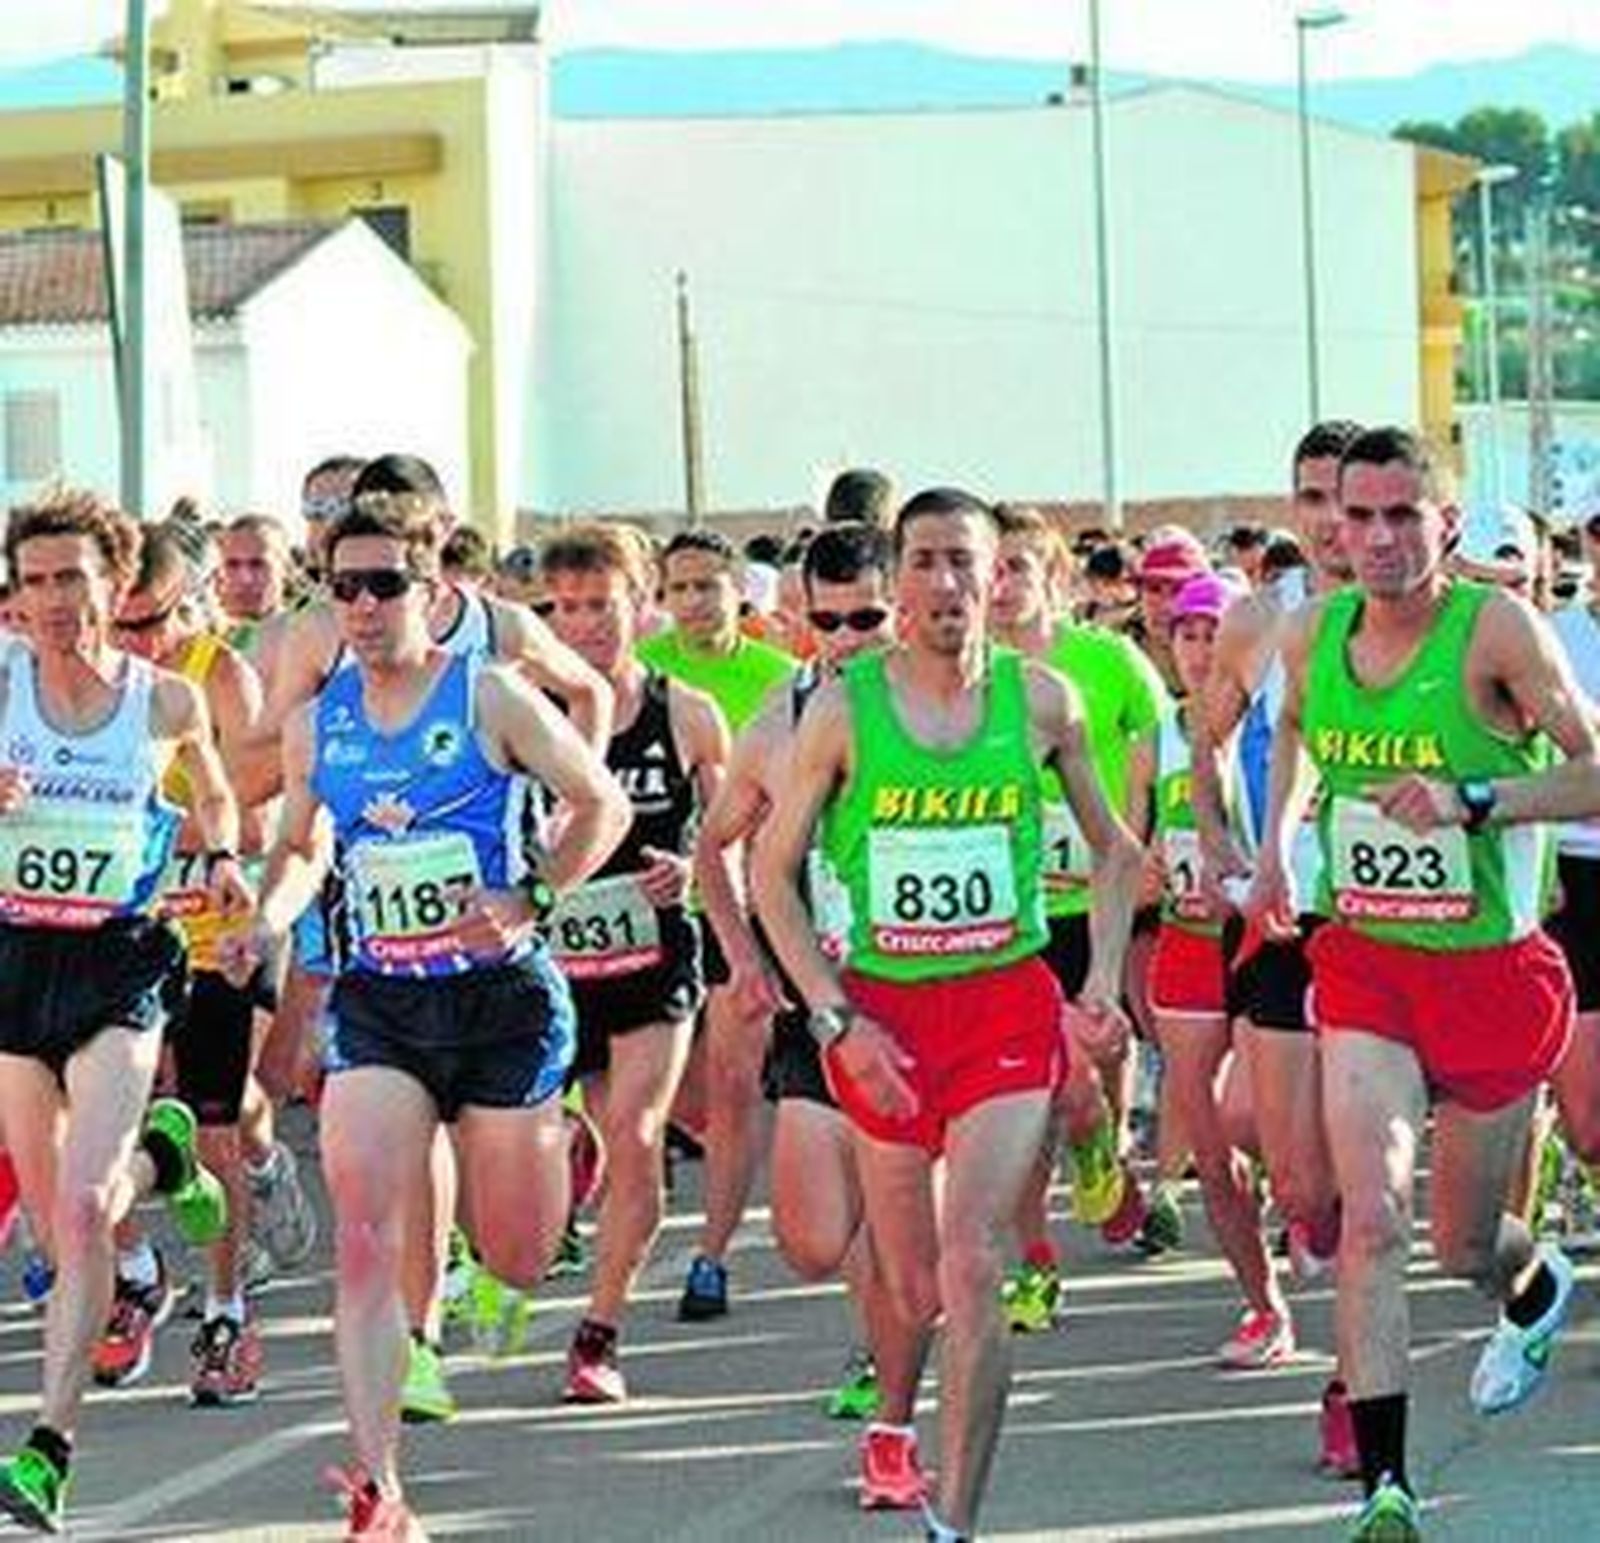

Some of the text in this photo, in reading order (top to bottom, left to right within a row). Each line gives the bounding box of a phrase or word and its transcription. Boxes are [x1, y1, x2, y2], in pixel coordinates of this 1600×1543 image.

[16, 845, 113, 894] 697
[1352, 841, 1447, 891] 823
[367, 870, 474, 931] 1187
[893, 868, 993, 922] 830
